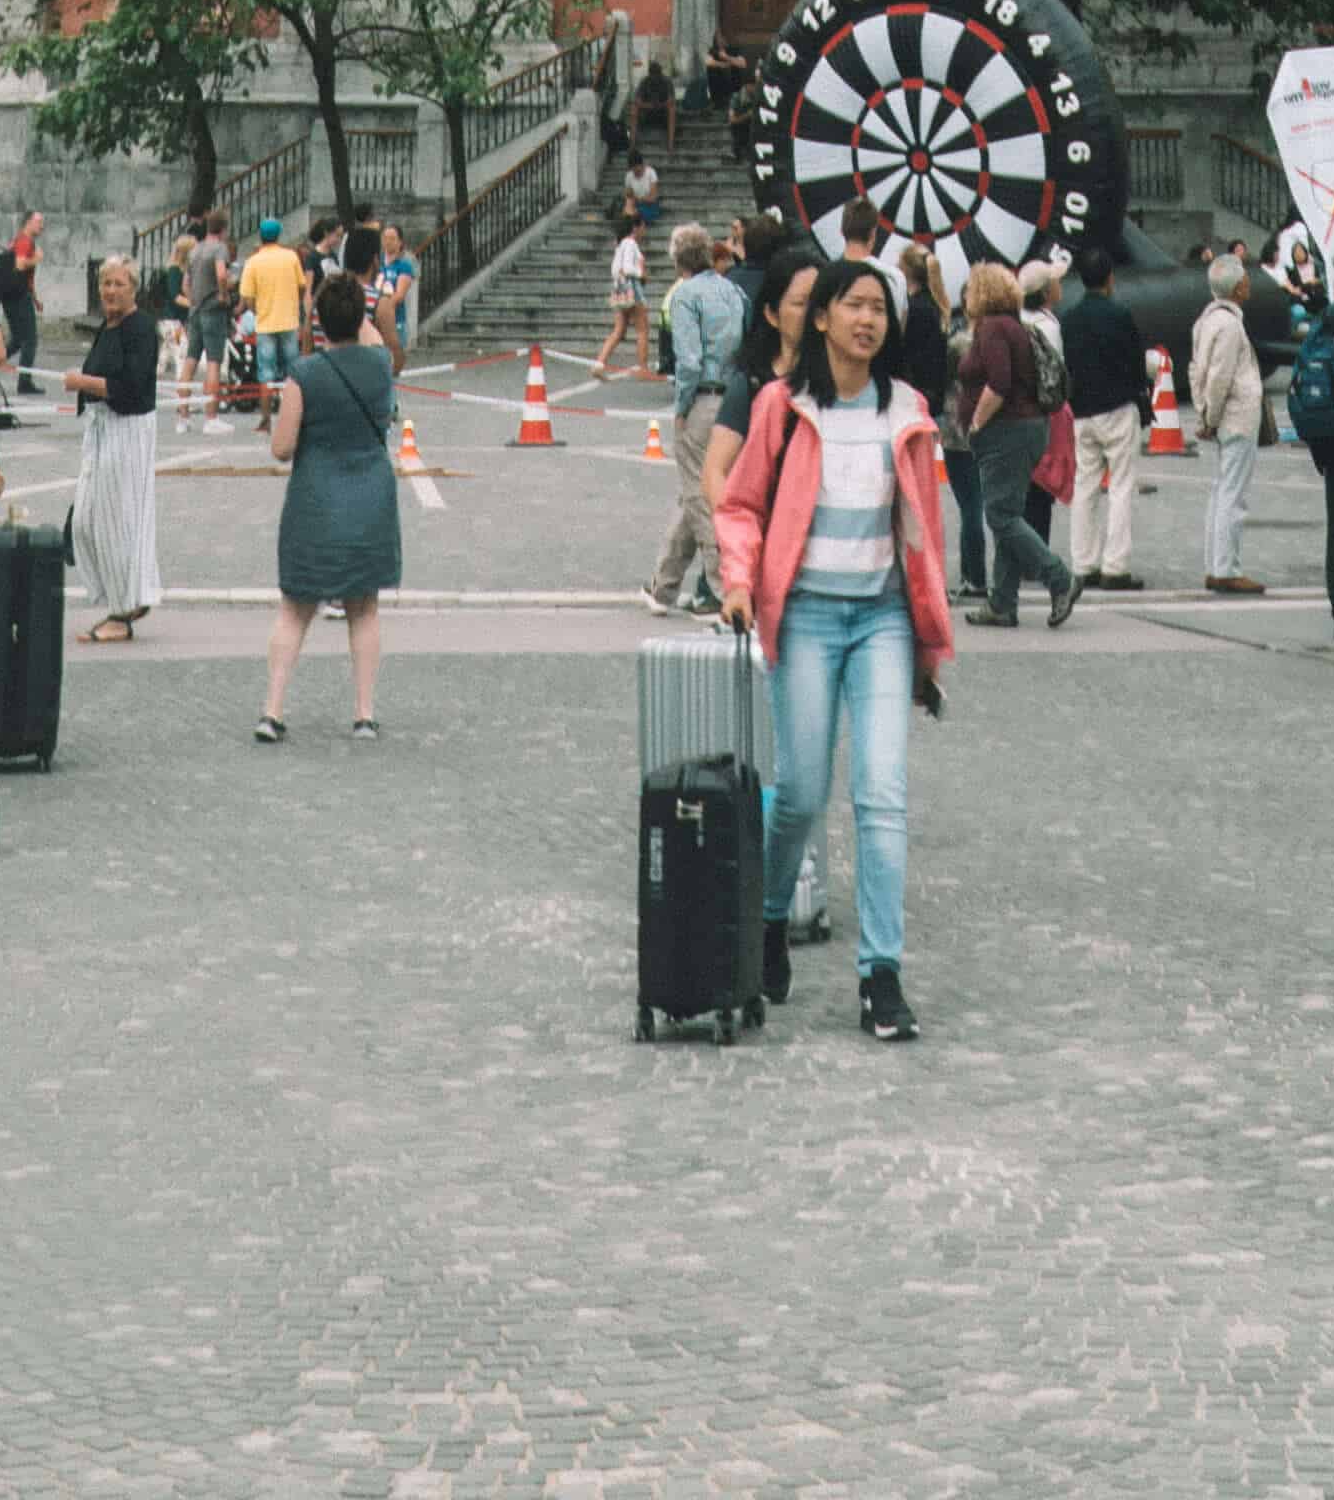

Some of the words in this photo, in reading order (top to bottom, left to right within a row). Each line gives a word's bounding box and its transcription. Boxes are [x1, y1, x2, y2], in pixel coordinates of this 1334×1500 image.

[776, 42, 798, 67] 9
[1027, 33, 1052, 57] 4
[758, 84, 784, 125] 14
[1050, 71, 1081, 118] 13
[754, 142, 775, 181] 11
[1067, 140, 1091, 166] 6
[1063, 191, 1090, 235] 10
